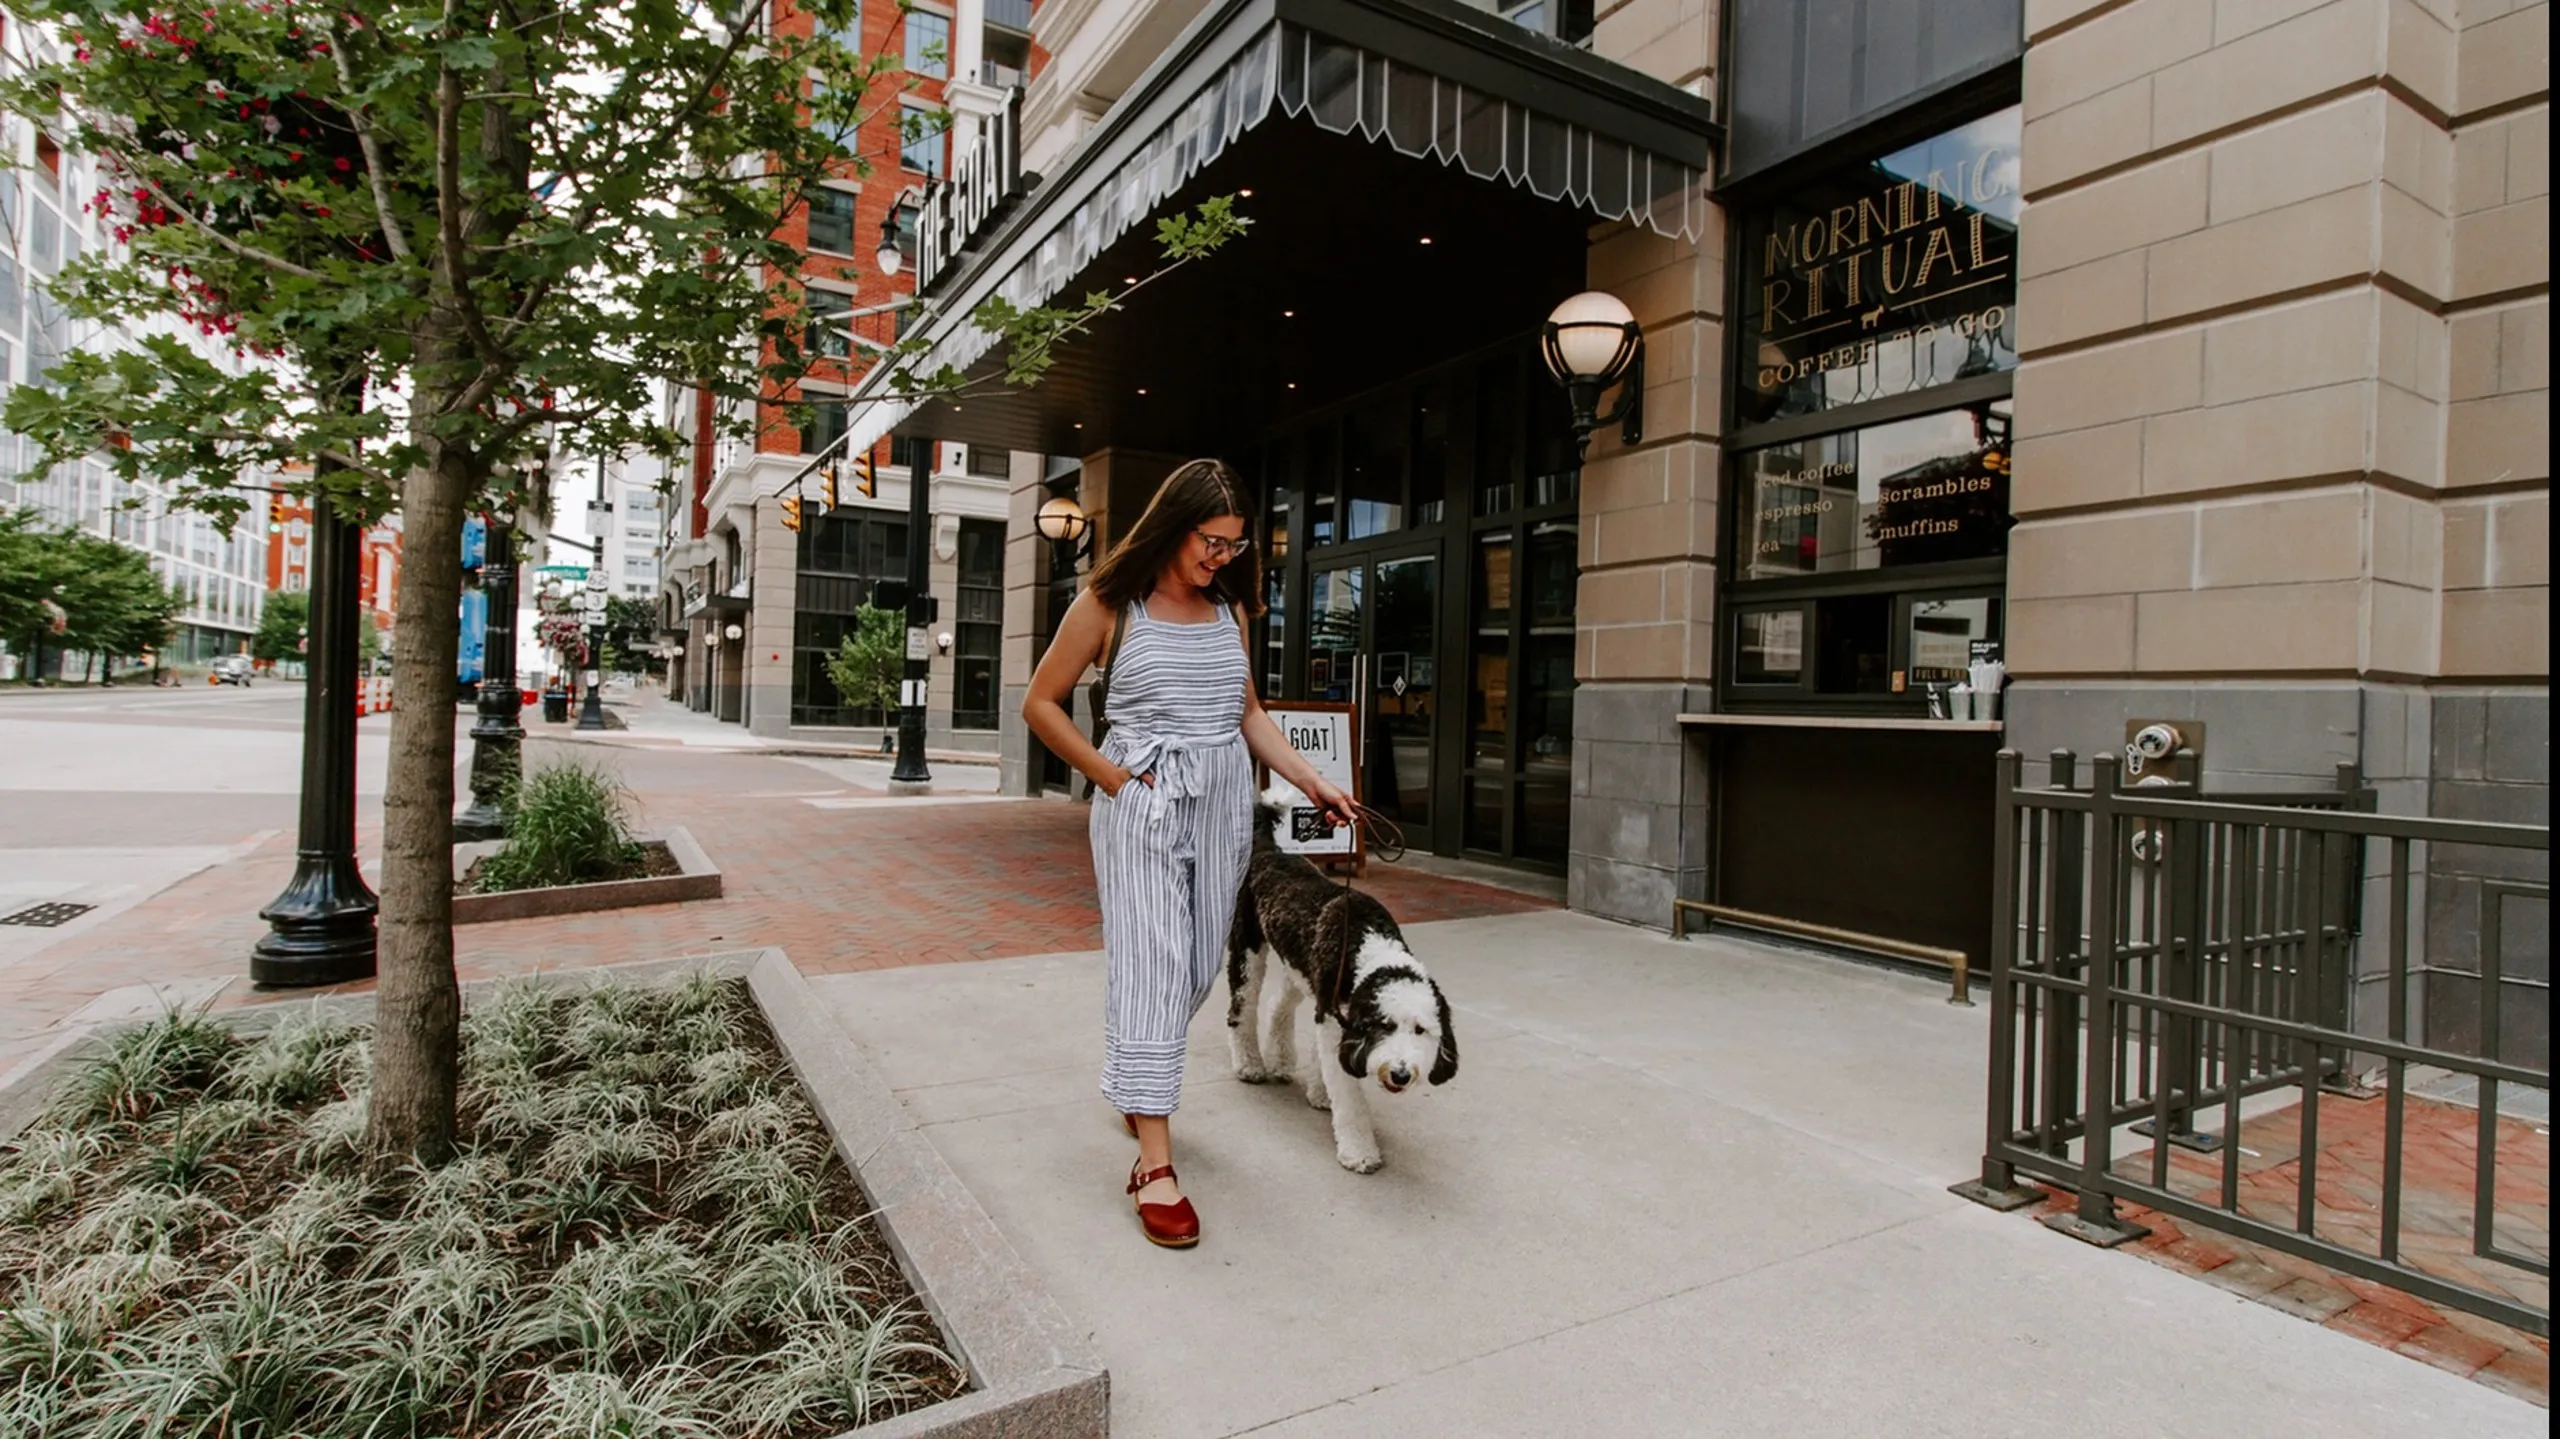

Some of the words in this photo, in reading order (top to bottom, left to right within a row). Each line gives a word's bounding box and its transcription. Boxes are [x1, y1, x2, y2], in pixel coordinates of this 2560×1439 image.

[914, 181, 946, 296] THE
[950, 86, 1018, 256] GOAT
[1764, 149, 2012, 277] MORNING
[1761, 212, 2009, 333] RITUAL
[1758, 339, 1878, 387] COFFEE
[1954, 305, 2006, 340] GO
[1798, 461, 1854, 482] coffee
[1879, 474, 1991, 504] scrambles
[1754, 499, 1833, 523] espresso
[1879, 517, 1959, 540] muffins
[592, 594, 601, 608] 3
[1290, 727, 1329, 751] GOAT
